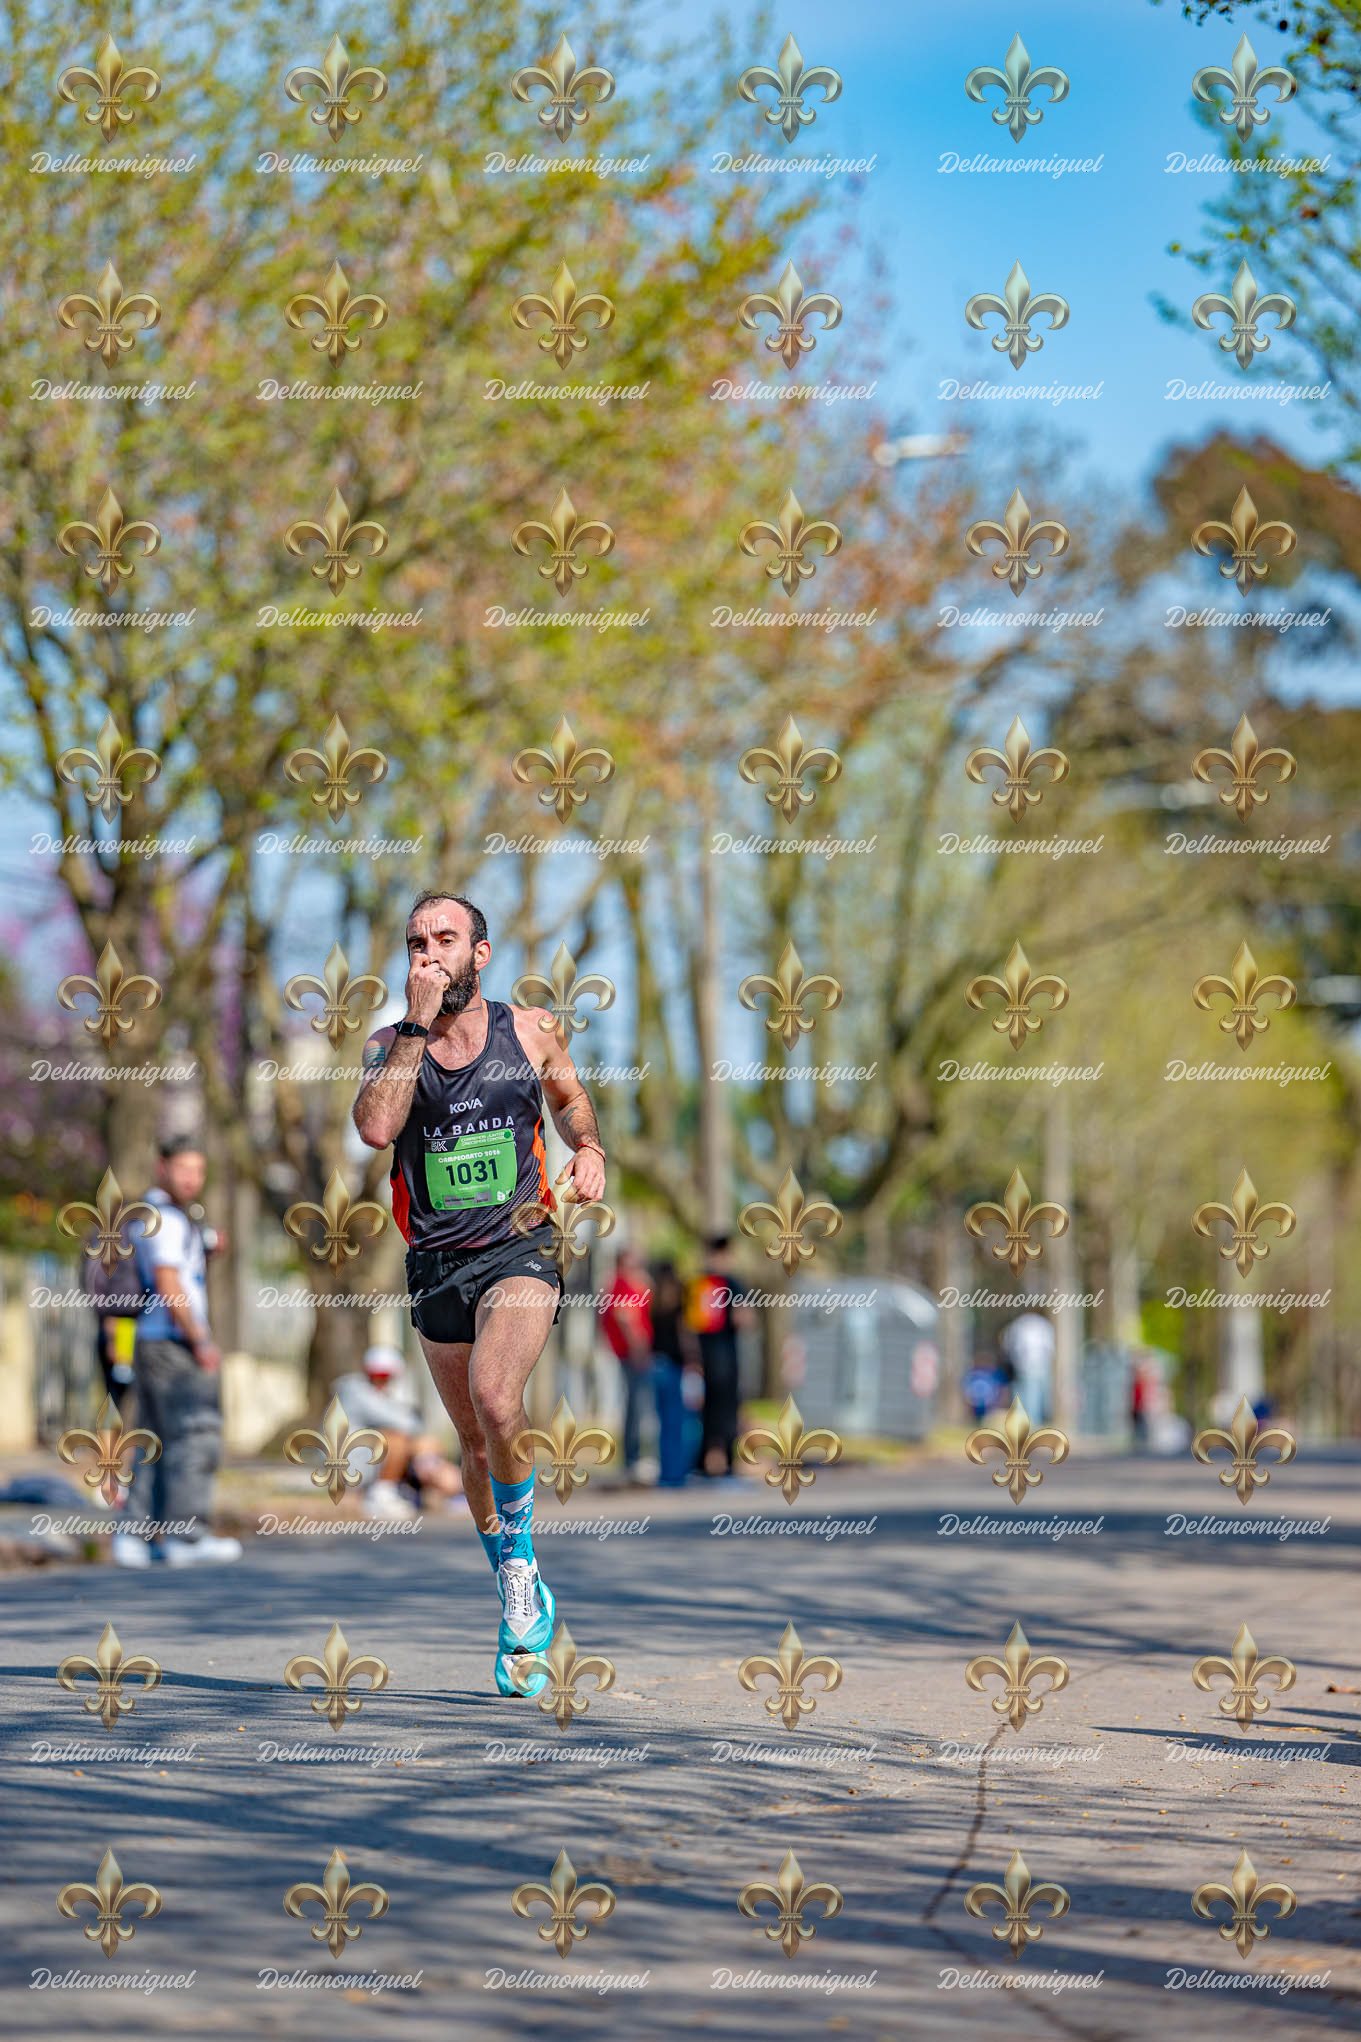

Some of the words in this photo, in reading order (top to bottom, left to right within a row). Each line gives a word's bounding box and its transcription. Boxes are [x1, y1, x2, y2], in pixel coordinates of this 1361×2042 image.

[449, 1098, 483, 1114] KOVA
[423, 1126, 443, 1138] LA
[452, 1116, 514, 1135] BANDA
[445, 1158, 498, 1187] 1031
